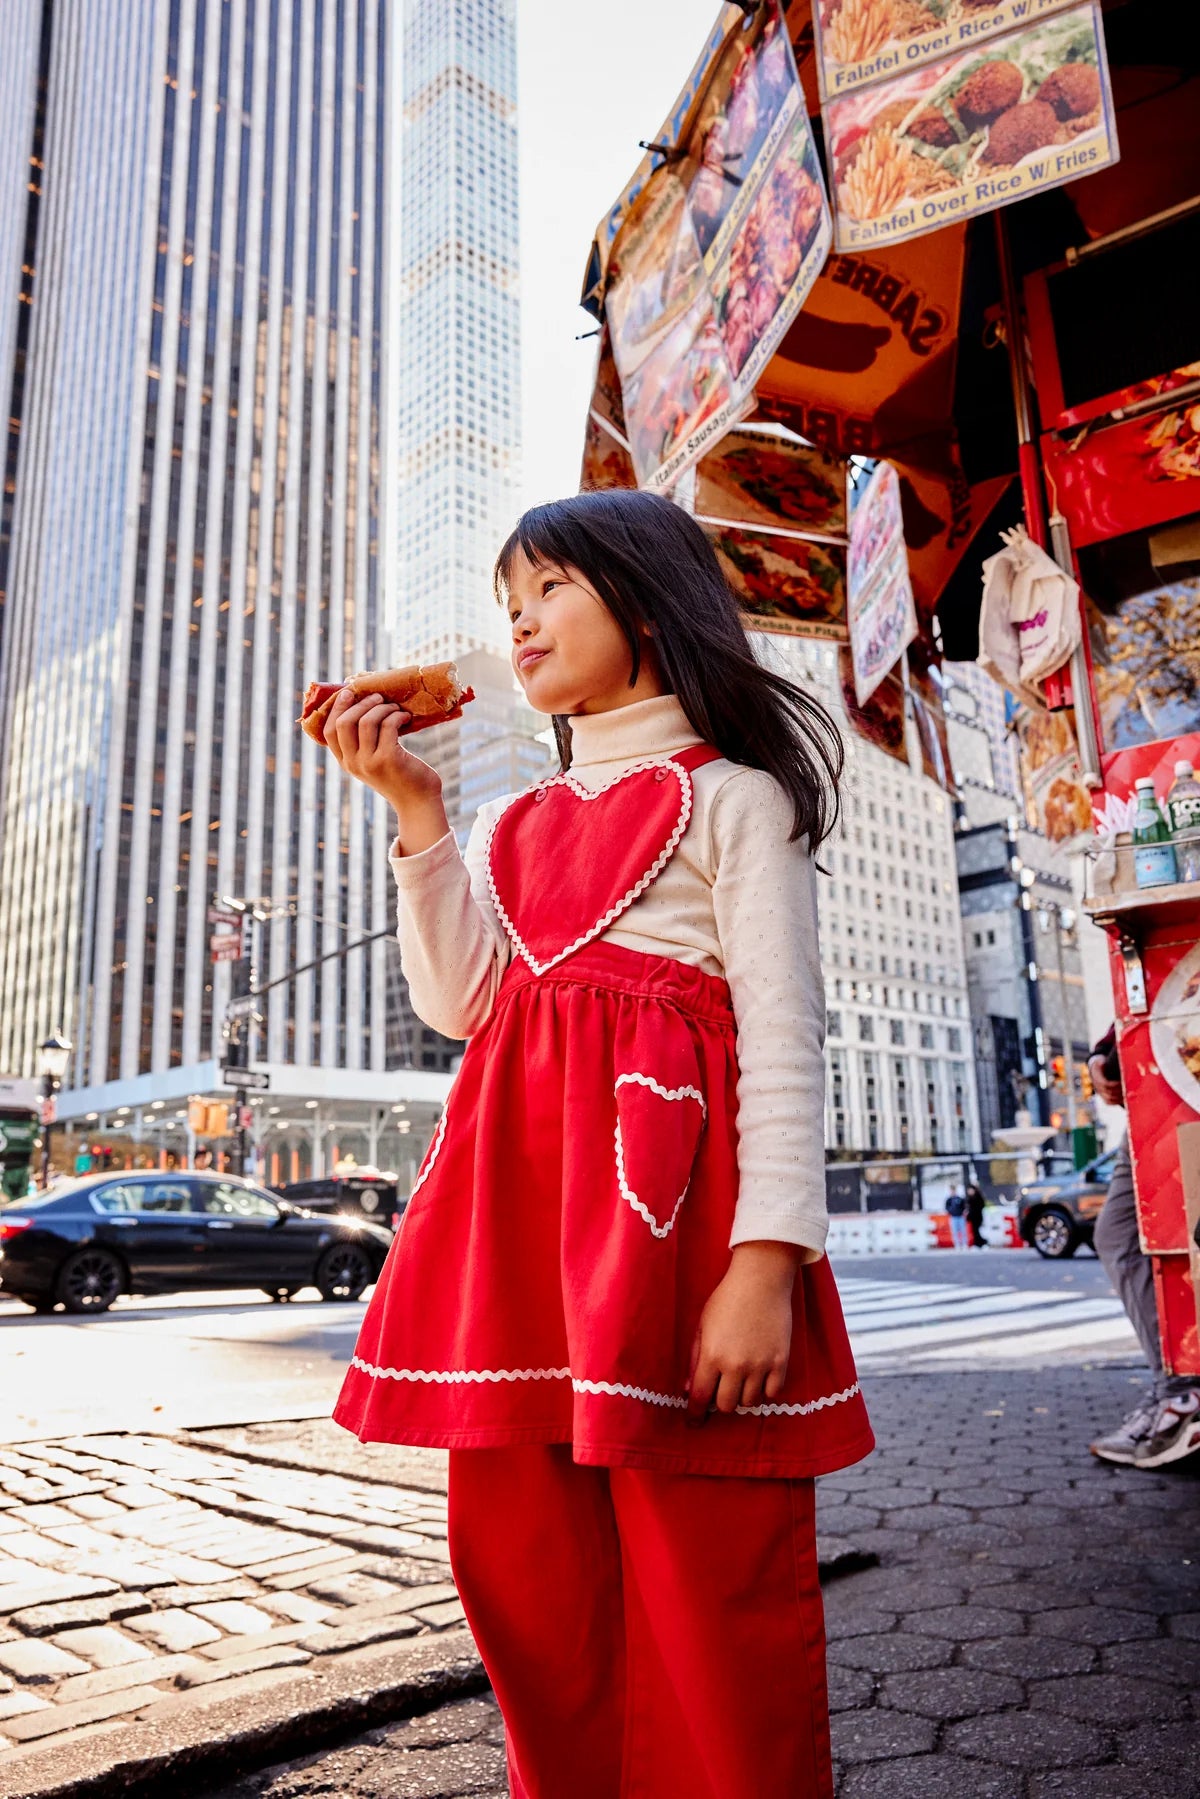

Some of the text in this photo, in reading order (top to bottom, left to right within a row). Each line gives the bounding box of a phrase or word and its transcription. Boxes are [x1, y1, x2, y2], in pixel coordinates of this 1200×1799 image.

[834, 0, 1033, 88] Falafel Over Rice W/
[848, 145, 1098, 243] Falafel Over Rice W/ Fries
[740, 247, 824, 388] Halal Chicken Kebab
[654, 451, 687, 487] Italian
